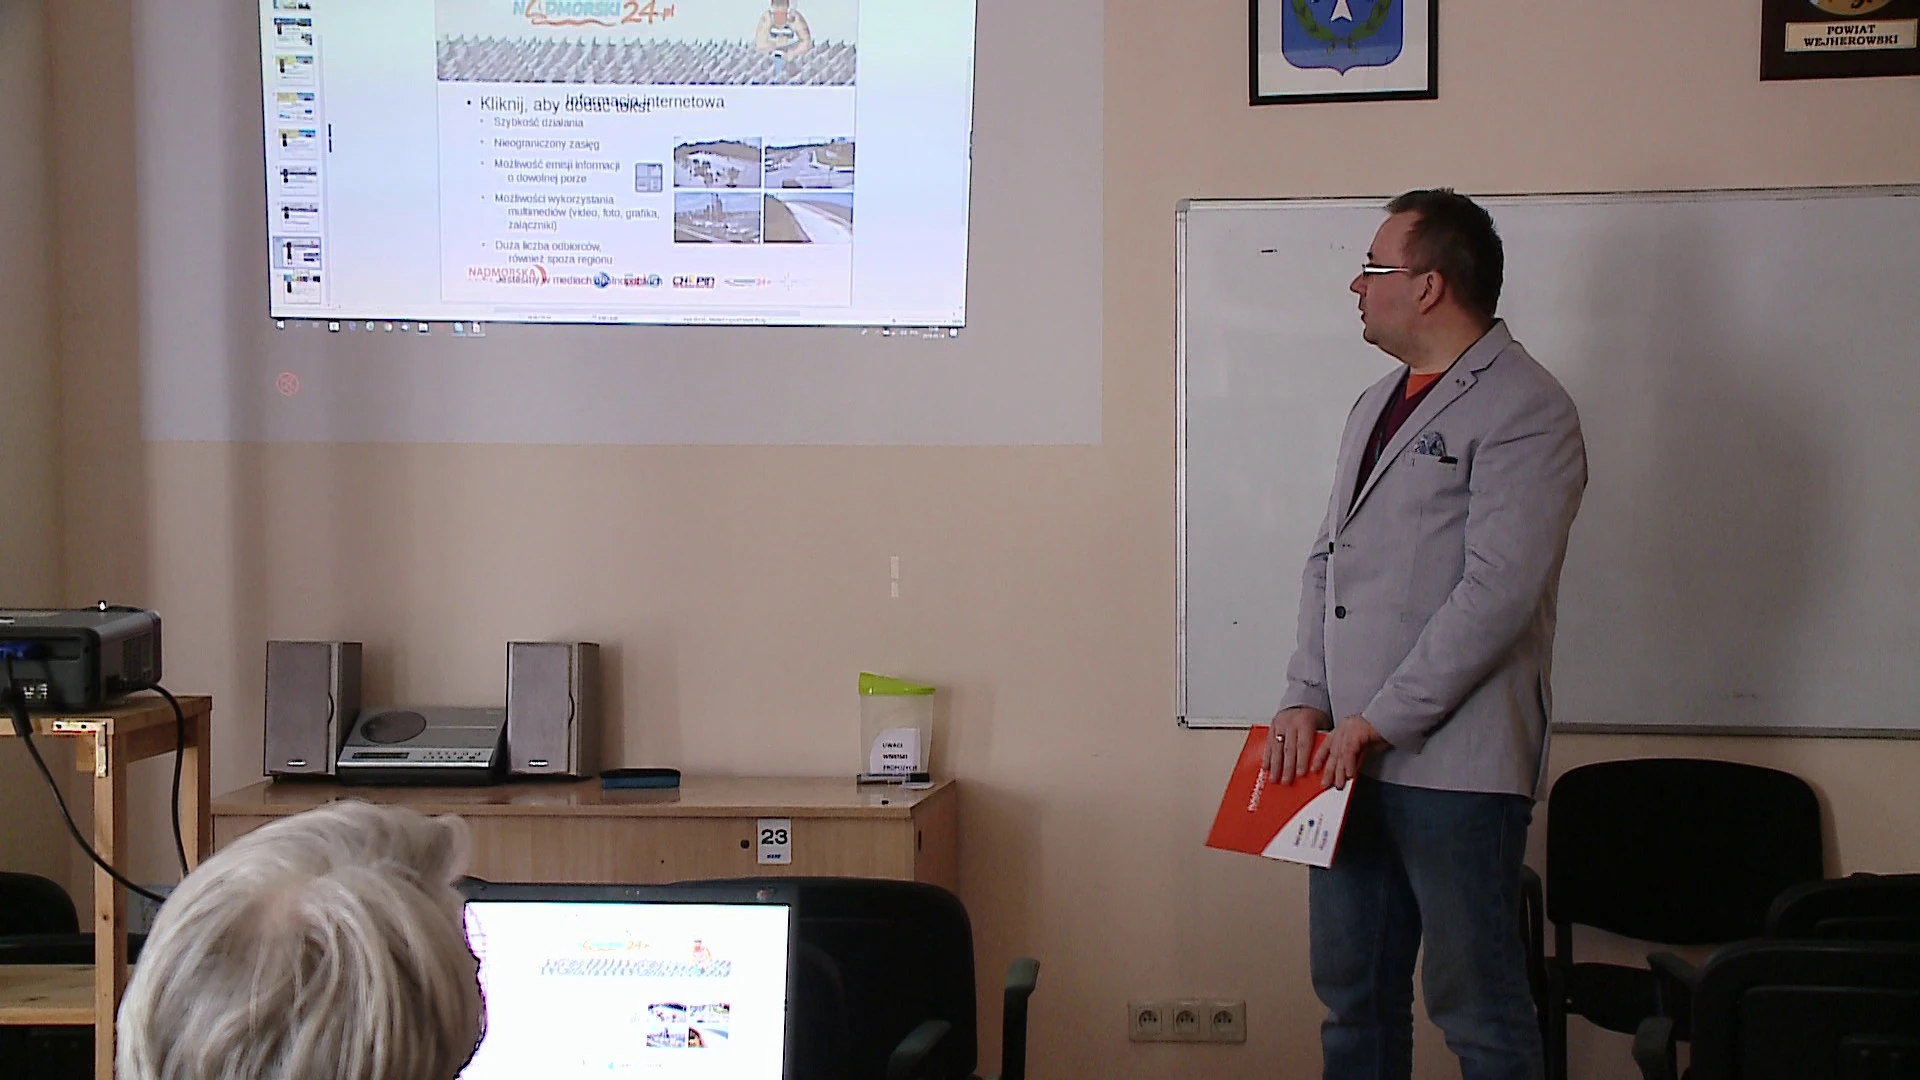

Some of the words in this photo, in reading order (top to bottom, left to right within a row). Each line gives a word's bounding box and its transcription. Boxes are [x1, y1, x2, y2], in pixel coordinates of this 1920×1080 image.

[1827, 24, 1876, 35] POWIAT
[1803, 35, 1899, 47] WEJHEROWSKI
[480, 96, 528, 114] Kliknij,
[533, 97, 560, 115] aby
[643, 94, 725, 108] internetowa
[494, 117, 540, 128] Szybkość
[494, 137, 567, 149] Nieograniczony
[494, 159, 544, 170] Możliwość
[545, 160, 573, 172] emisji
[575, 161, 621, 173] informacji
[516, 174, 558, 185] dowolnej
[560, 177, 588, 185] porze
[494, 194, 546, 204] Możliwości
[547, 195, 615, 206] wykorzystania
[507, 206, 566, 217] multimediów
[568, 208, 601, 219] (video,
[602, 208, 624, 219] foto,
[625, 209, 660, 220] grafika,
[495, 240, 521, 250] Duża
[522, 240, 550, 251] liczba
[551, 242, 602, 253] odbiorców,
[508, 254, 545, 264] również
[547, 256, 576, 266] spoza
[577, 257, 613, 266] regionu
[468, 267, 536, 278] NADMORSKA
[552, 275, 593, 286] mediach
[761, 829, 788, 845] 23
